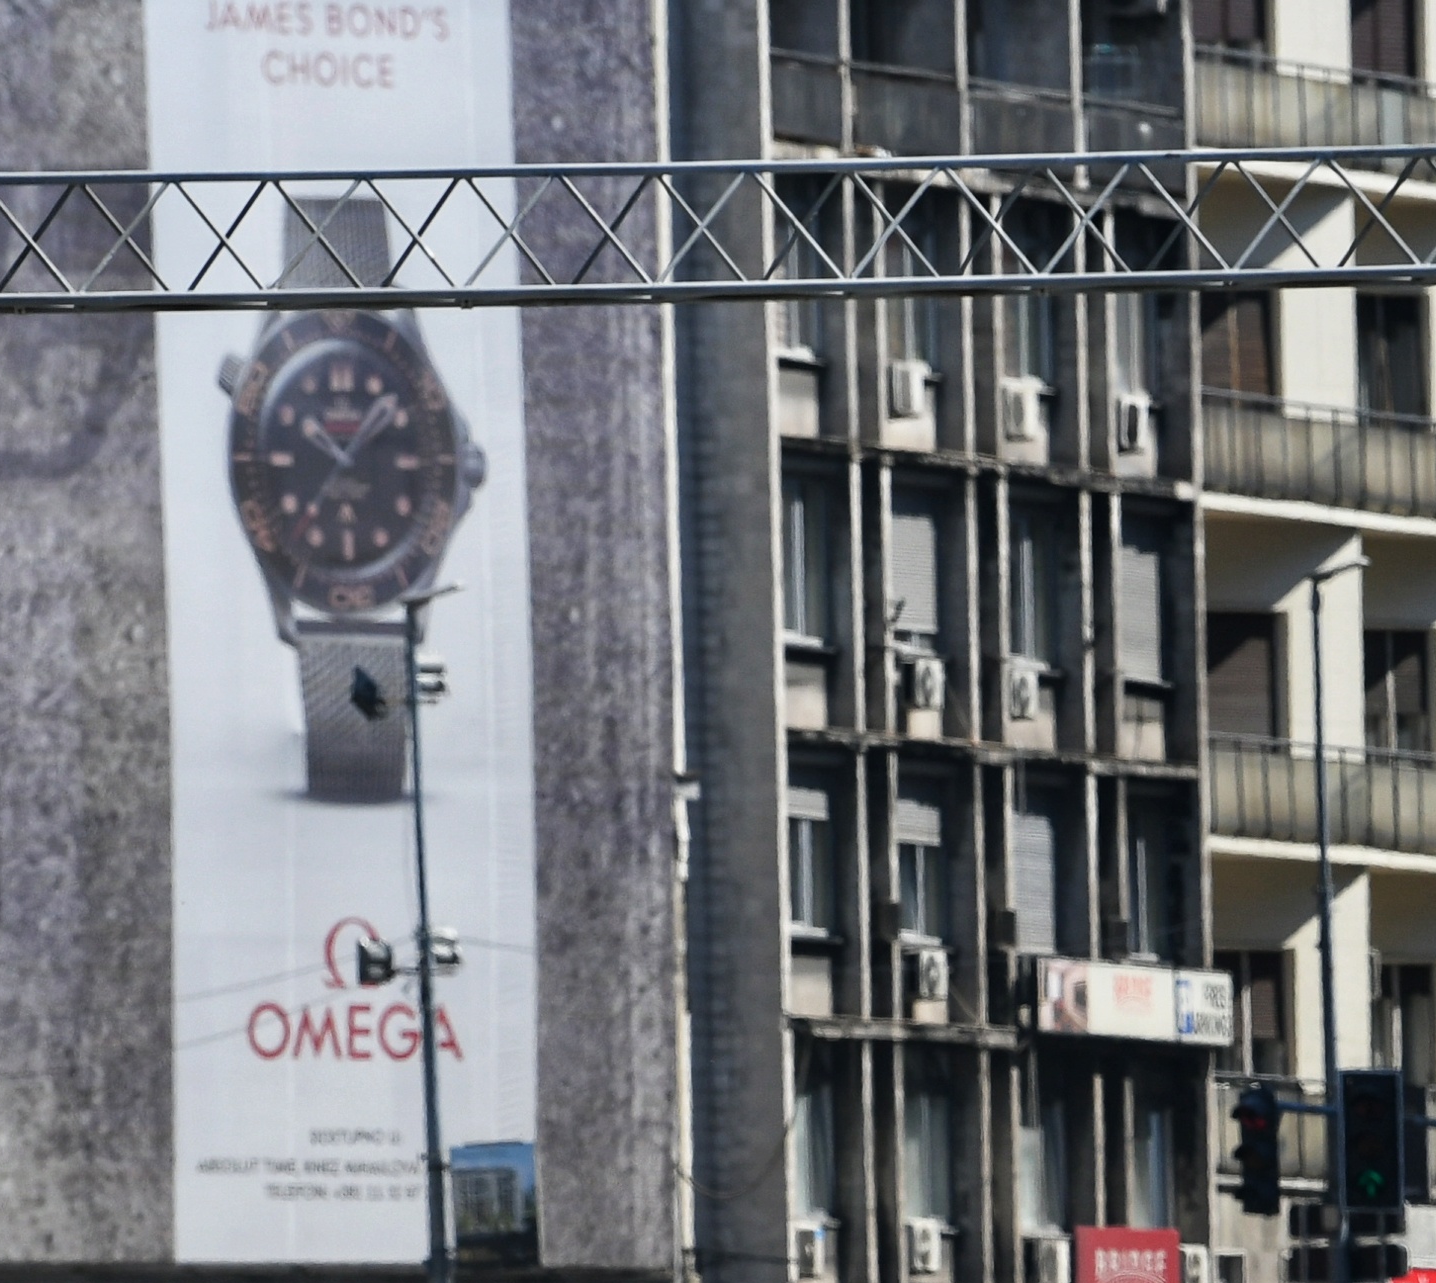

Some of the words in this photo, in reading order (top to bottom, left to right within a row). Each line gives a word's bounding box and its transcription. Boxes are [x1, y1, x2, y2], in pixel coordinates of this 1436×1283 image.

[204, 0, 315, 37] JAMES
[325, 0, 452, 42] BOND'S
[262, 50, 397, 88] CHOICE
[248, 1002, 463, 1061] OMEGA
